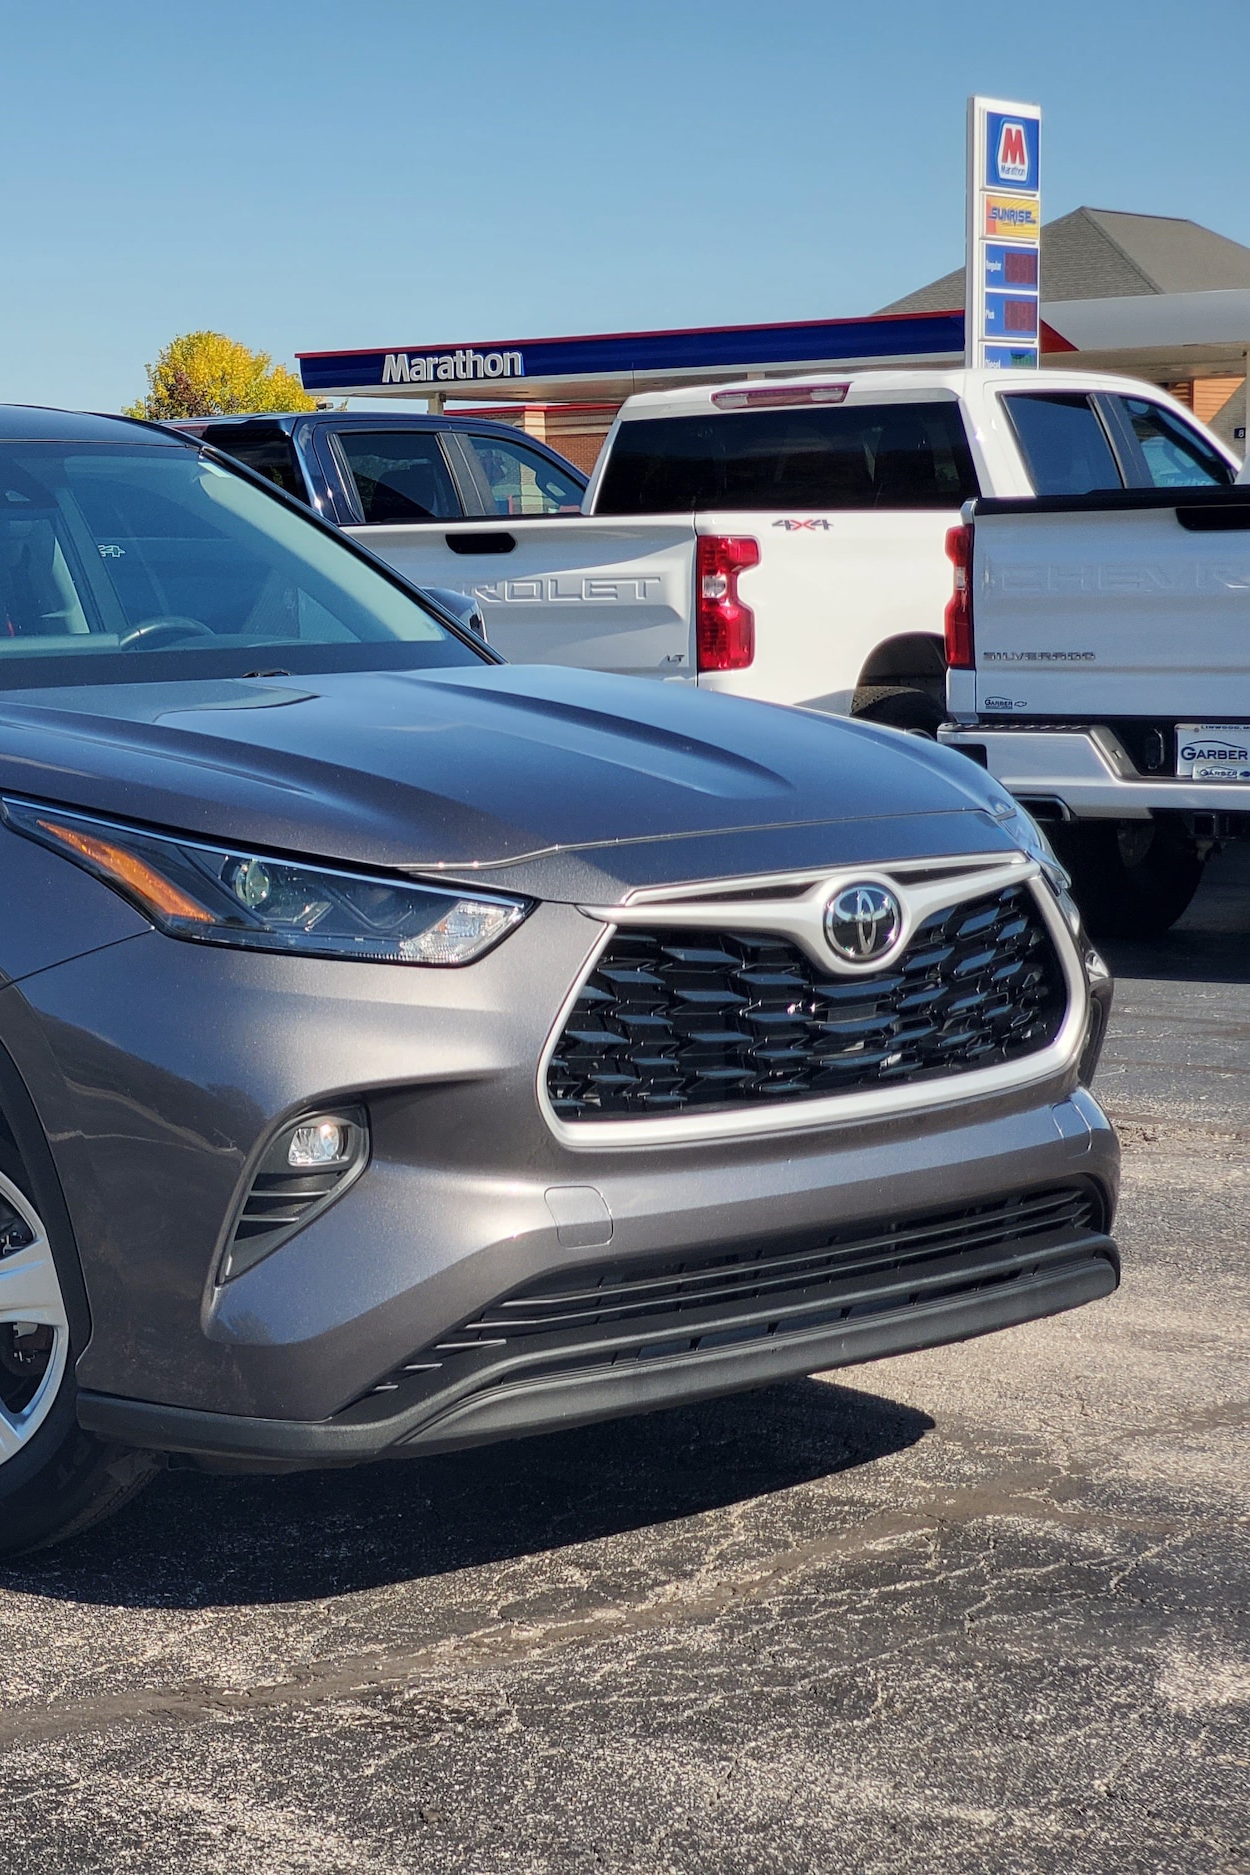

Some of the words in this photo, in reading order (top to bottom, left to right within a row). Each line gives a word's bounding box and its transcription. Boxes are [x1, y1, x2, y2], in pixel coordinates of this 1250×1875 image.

[1002, 127, 1025, 165] M
[1001, 164, 1026, 177] Marathon
[988, 206, 1036, 225] SUNRISE
[382, 349, 522, 383] Marathon
[666, 653, 685, 663] LT
[983, 651, 1096, 661] SILVERADO
[1181, 746, 1248, 761] GARBER
